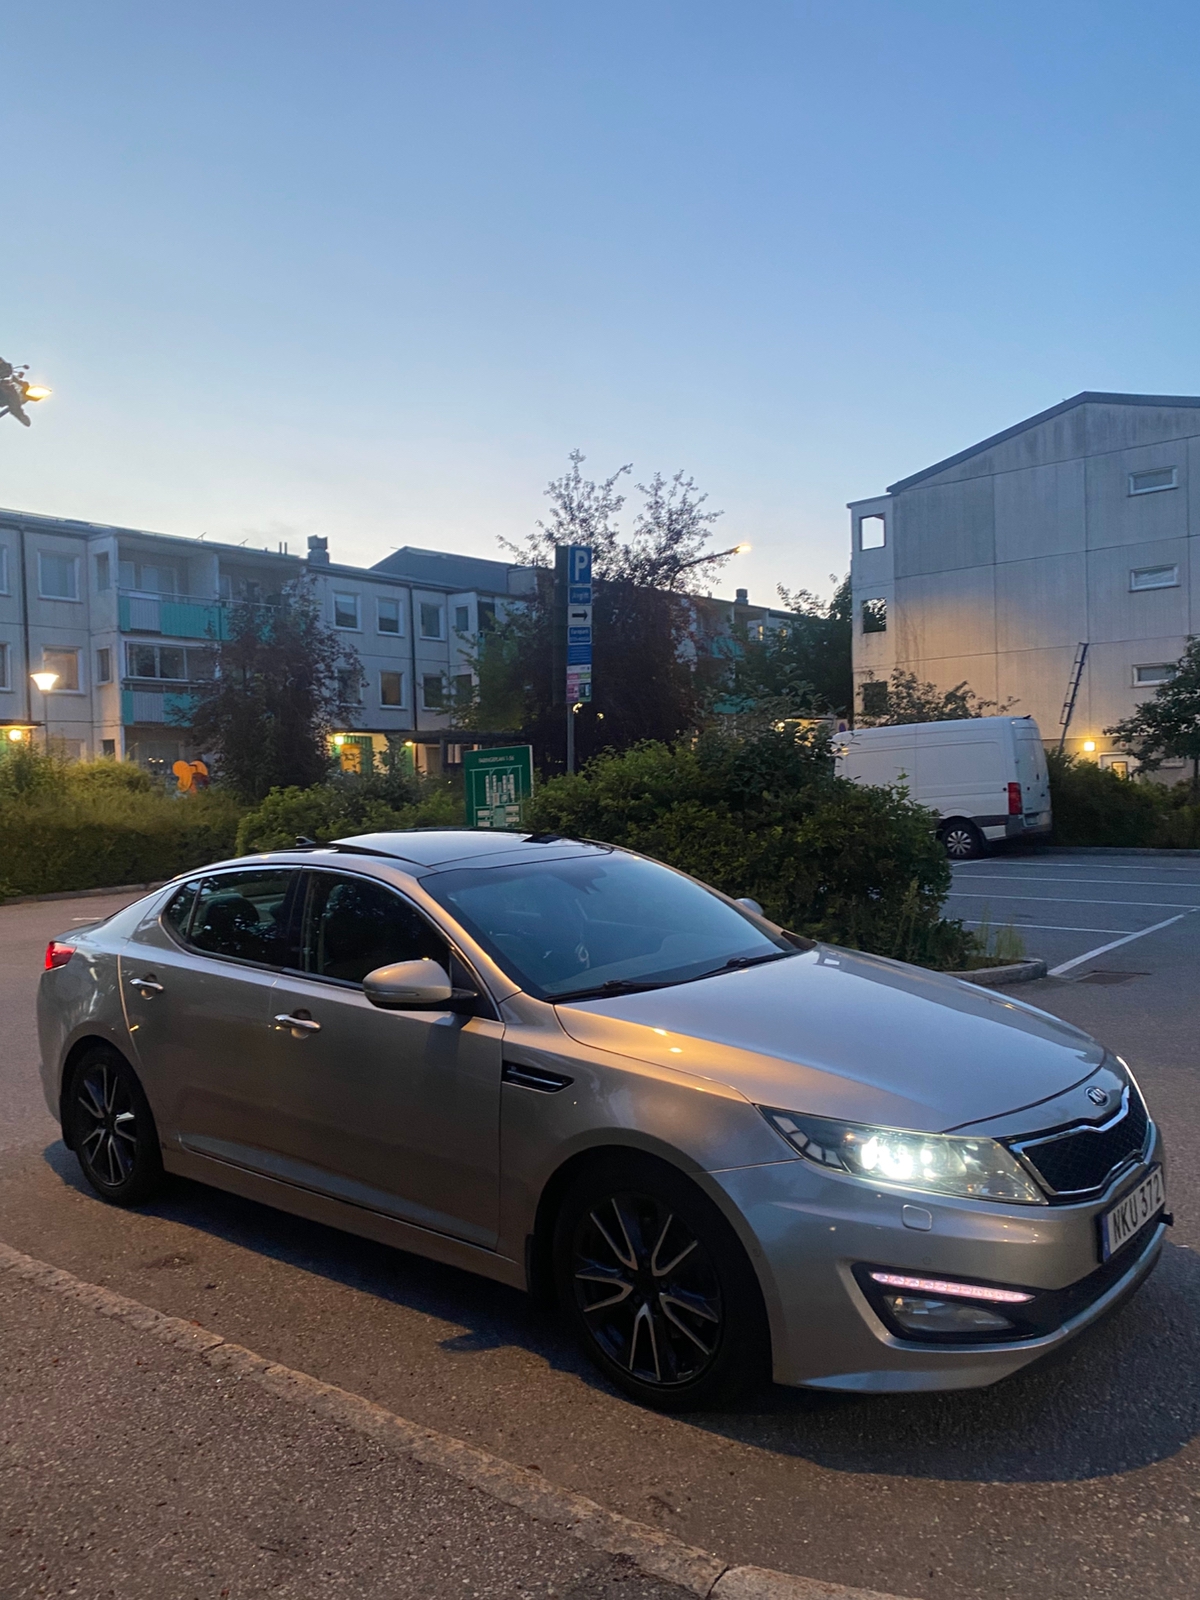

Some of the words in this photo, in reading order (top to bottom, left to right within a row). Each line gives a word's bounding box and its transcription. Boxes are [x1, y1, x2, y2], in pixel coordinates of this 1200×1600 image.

[575, 550, 588, 581] P
[1112, 1195, 1139, 1243] NKU
[1140, 1174, 1161, 1217] 372
